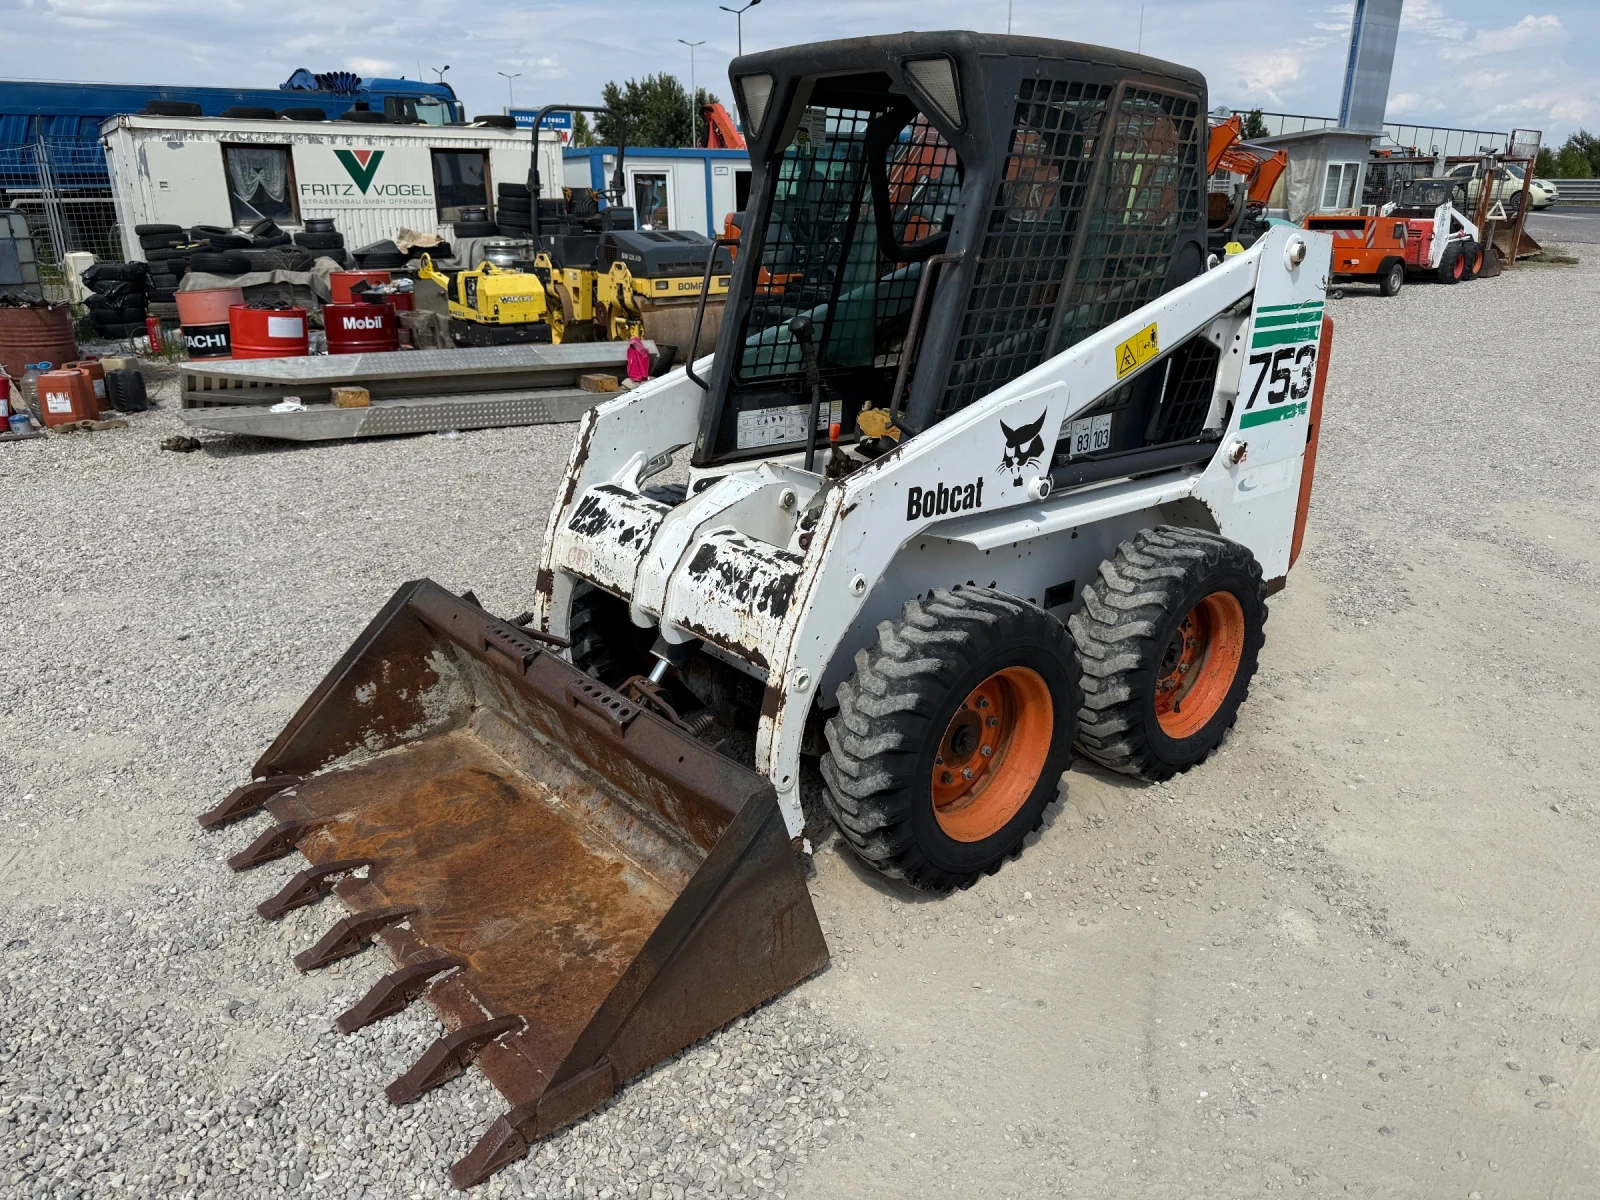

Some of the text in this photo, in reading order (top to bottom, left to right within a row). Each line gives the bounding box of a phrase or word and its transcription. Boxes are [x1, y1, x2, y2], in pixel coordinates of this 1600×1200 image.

[300, 184, 433, 196] FRITZ VOGEL
[343, 316, 382, 330] Mobil
[1245, 344, 1317, 410] 753
[1077, 433, 1089, 452] 83
[1093, 428, 1109, 449] 103
[907, 476, 984, 521] Bobcat
